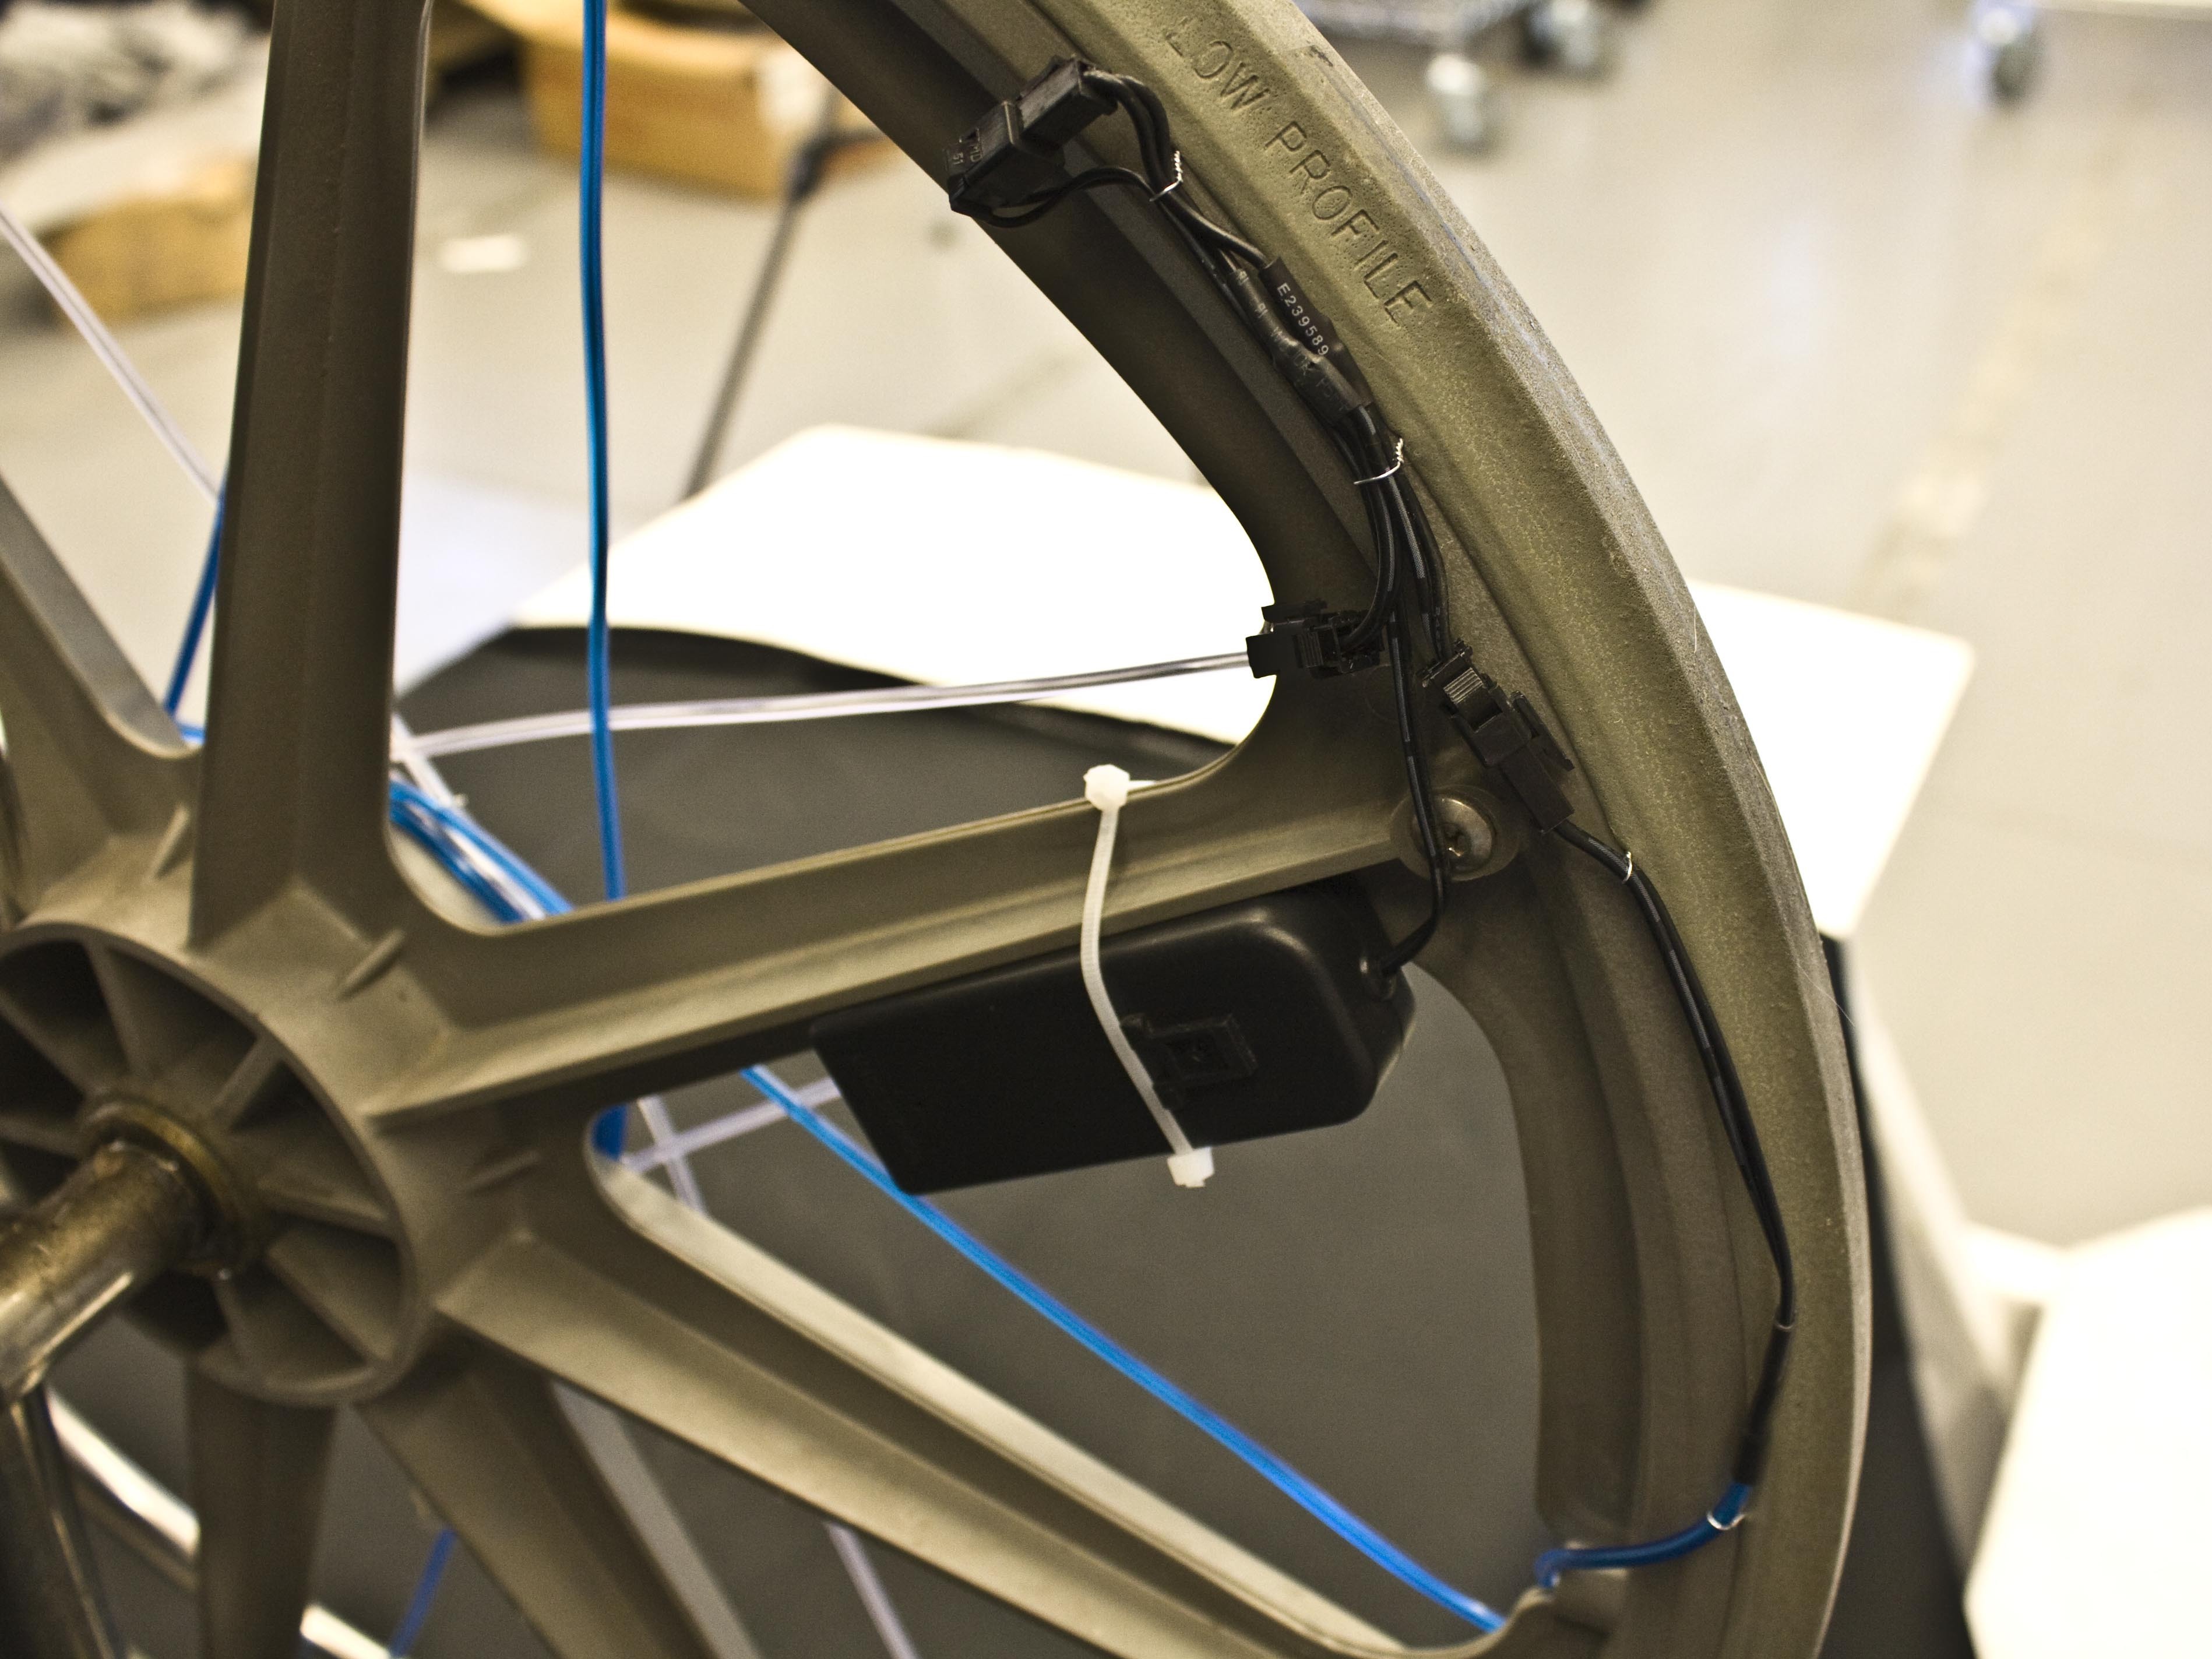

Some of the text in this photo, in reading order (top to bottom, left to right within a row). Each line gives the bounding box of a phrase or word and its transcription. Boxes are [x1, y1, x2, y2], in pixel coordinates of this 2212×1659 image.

[1165, 16, 1432, 325] LOW PROFILE
[1277, 282, 1329, 355] E239589
